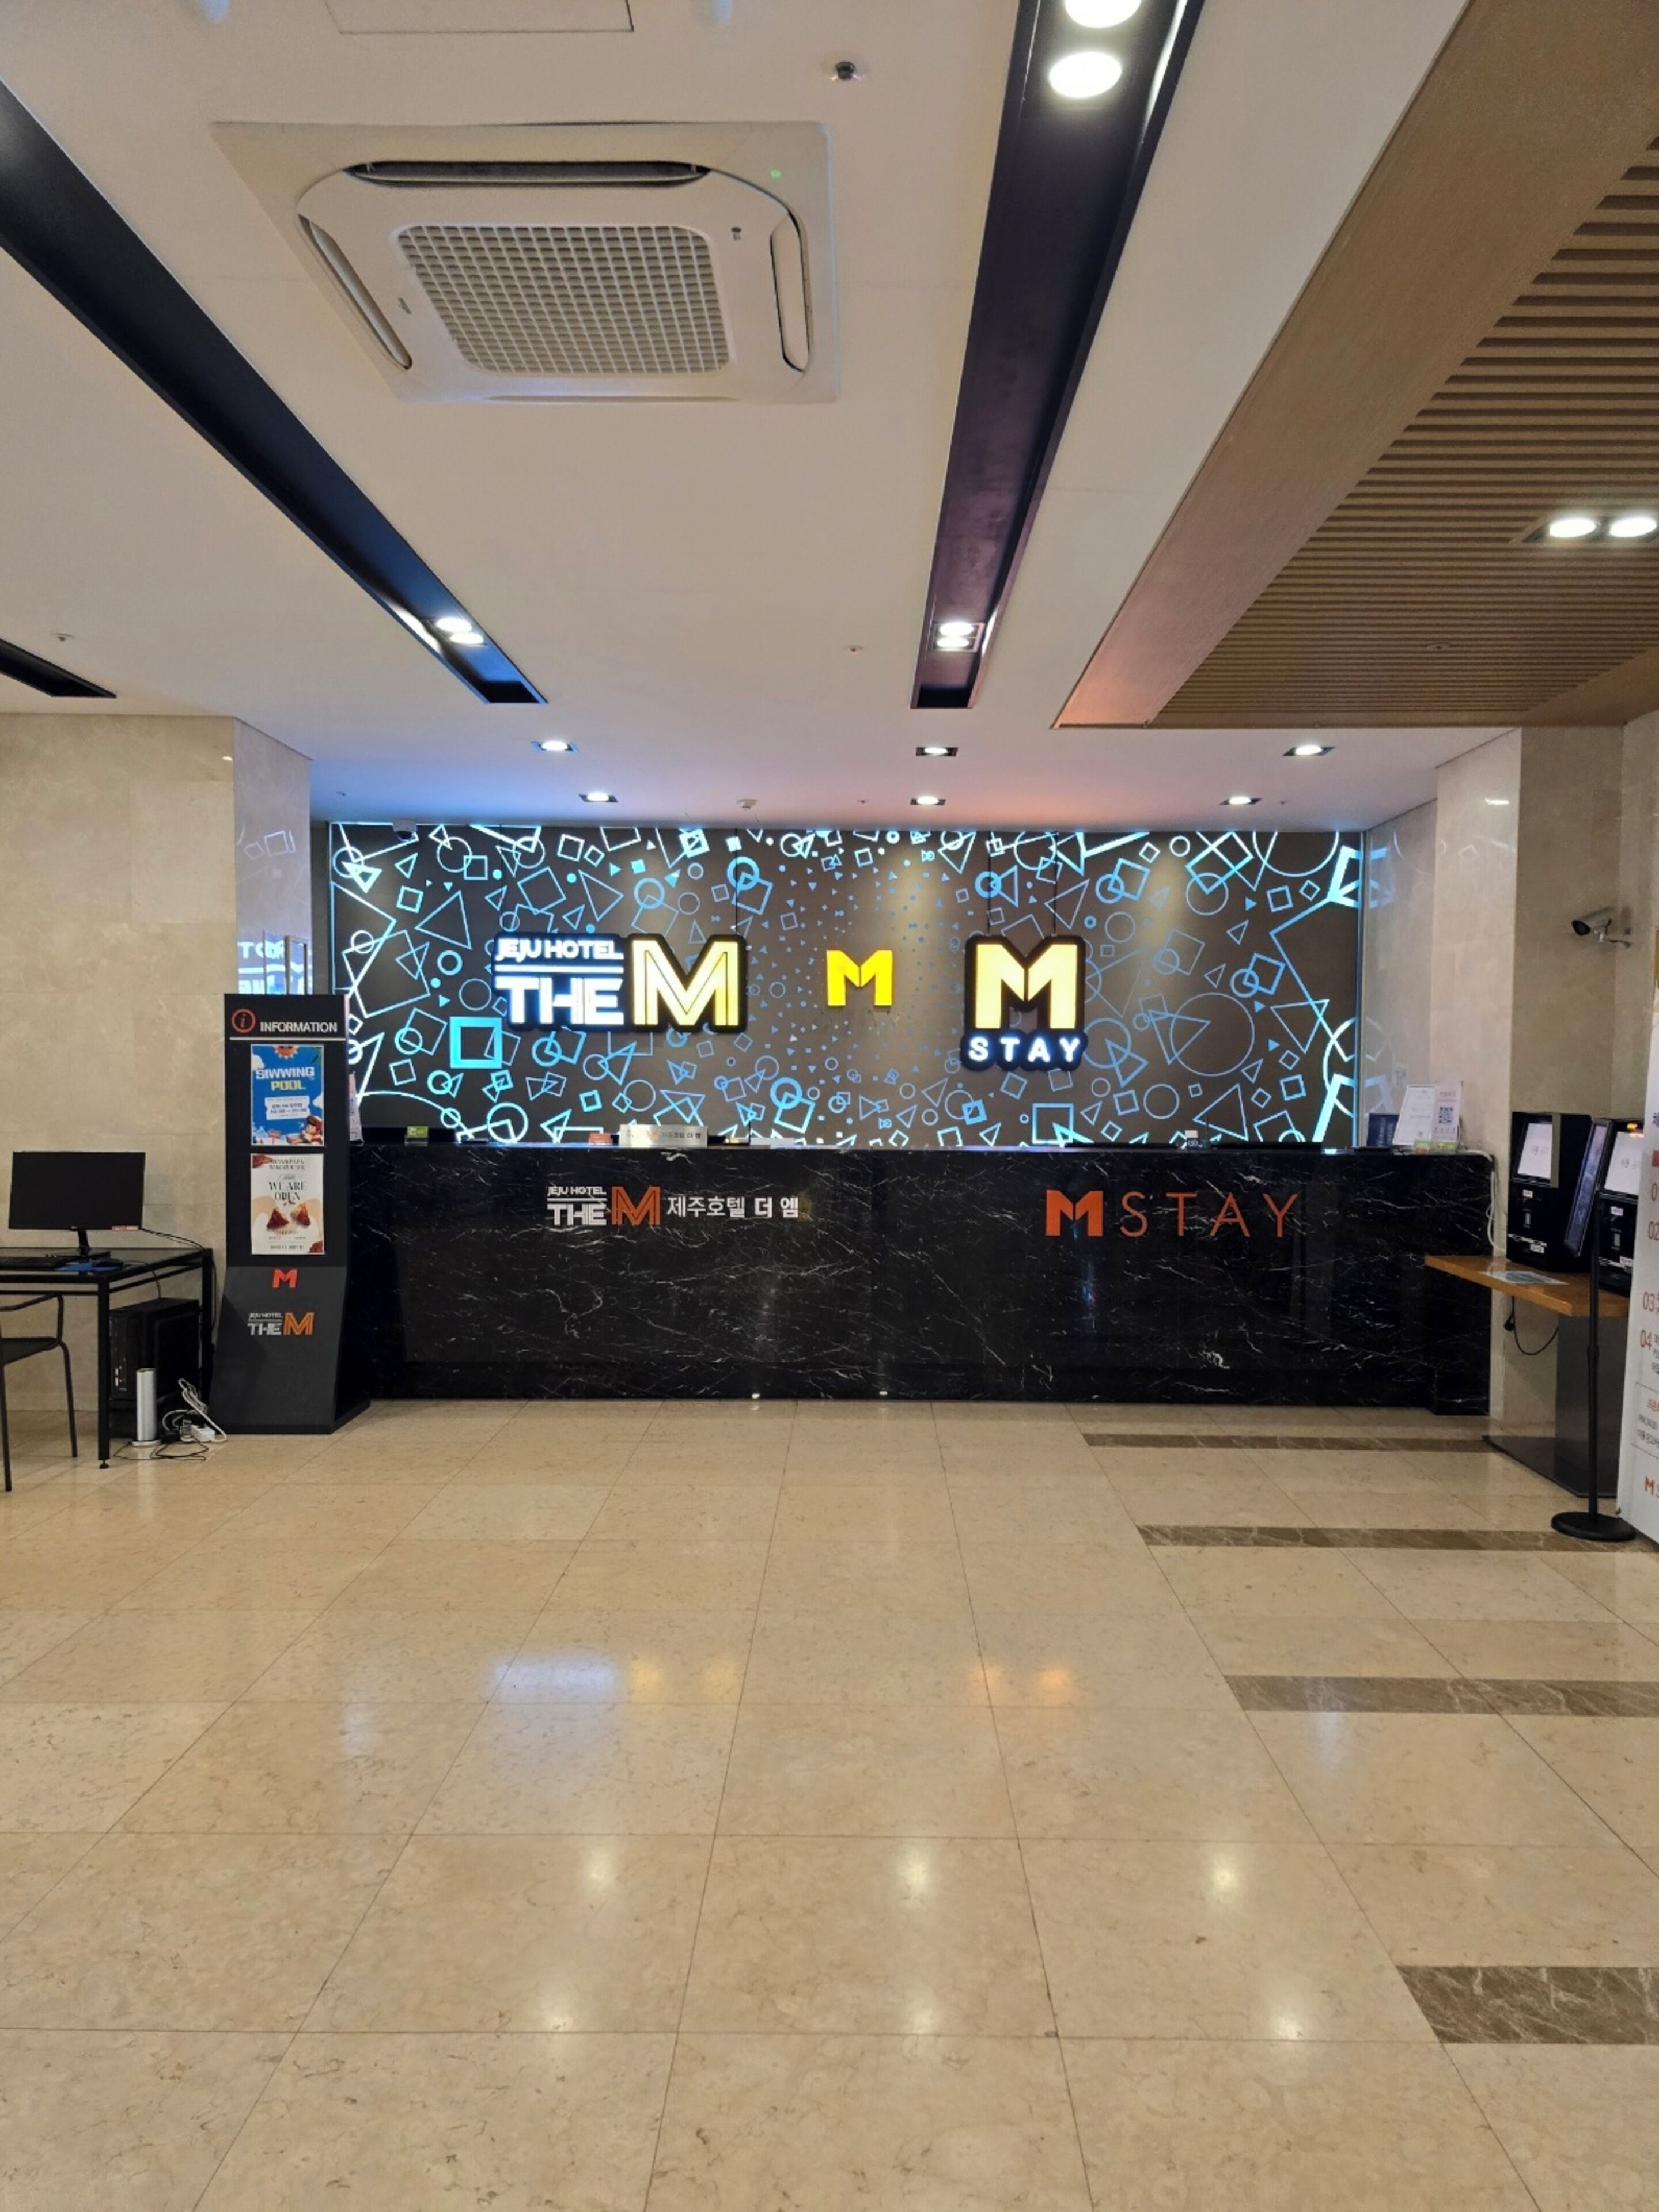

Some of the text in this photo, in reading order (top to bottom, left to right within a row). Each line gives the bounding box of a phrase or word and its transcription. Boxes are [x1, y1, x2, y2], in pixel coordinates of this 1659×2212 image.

[495, 939, 624, 962] JEJU HOTEL
[495, 941, 738, 1025] THE M
[827, 950, 892, 1006] M
[975, 944, 1078, 1029] M
[260, 1022, 338, 1033] INFORMATION
[968, 1036, 1081, 1062] STAY
[271, 1080, 306, 1091] POOL
[269, 1181, 306, 1191] WE ARE
[547, 1186, 607, 1196] JEJU HOTEL
[547, 1186, 661, 1226] THE M
[666, 1196, 799, 1218] 제주호텔 더 엠
[1046, 1190, 1298, 1238] M STAY
[272, 1268, 298, 1289] M
[1643, 1291, 1656, 1312] 03
[248, 1312, 315, 1336] THE M
[1640, 1329, 1652, 1350] 04
